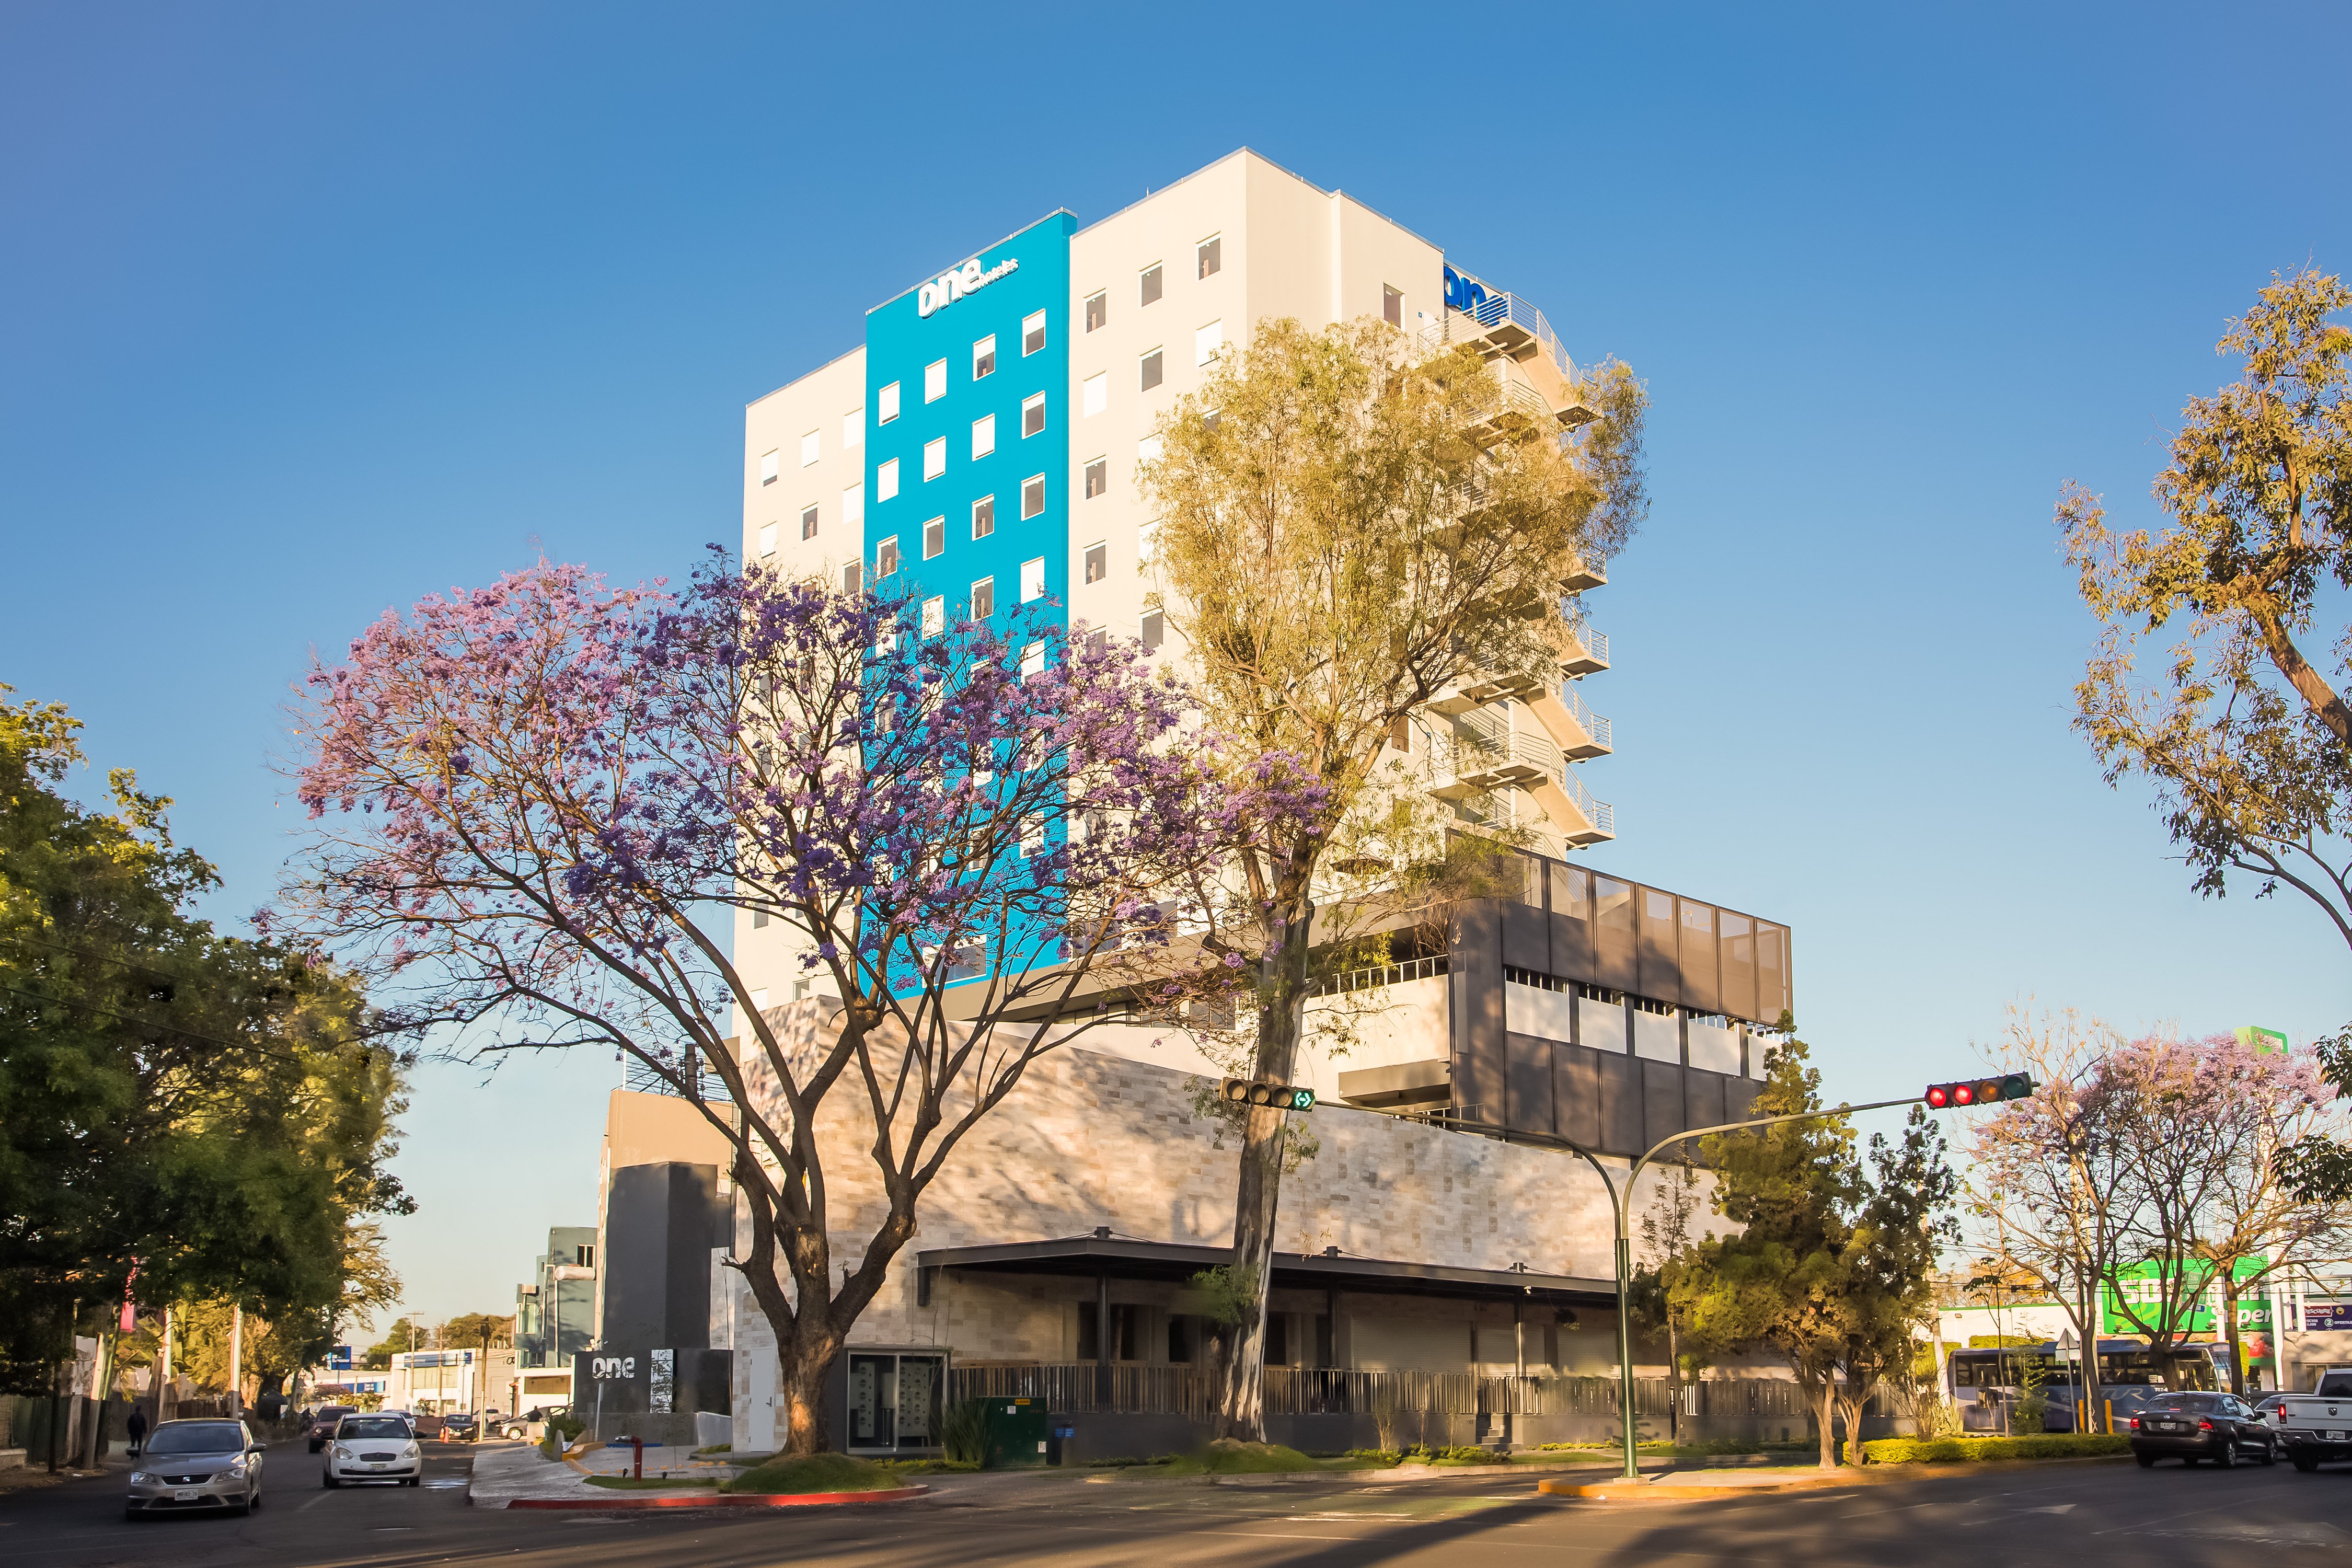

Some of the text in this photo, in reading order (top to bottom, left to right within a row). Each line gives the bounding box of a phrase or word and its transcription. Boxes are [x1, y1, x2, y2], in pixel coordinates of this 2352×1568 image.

[918, 258, 1019, 318] one hoteles
[1444, 266, 1507, 327] one
[592, 1357, 635, 1379] one
